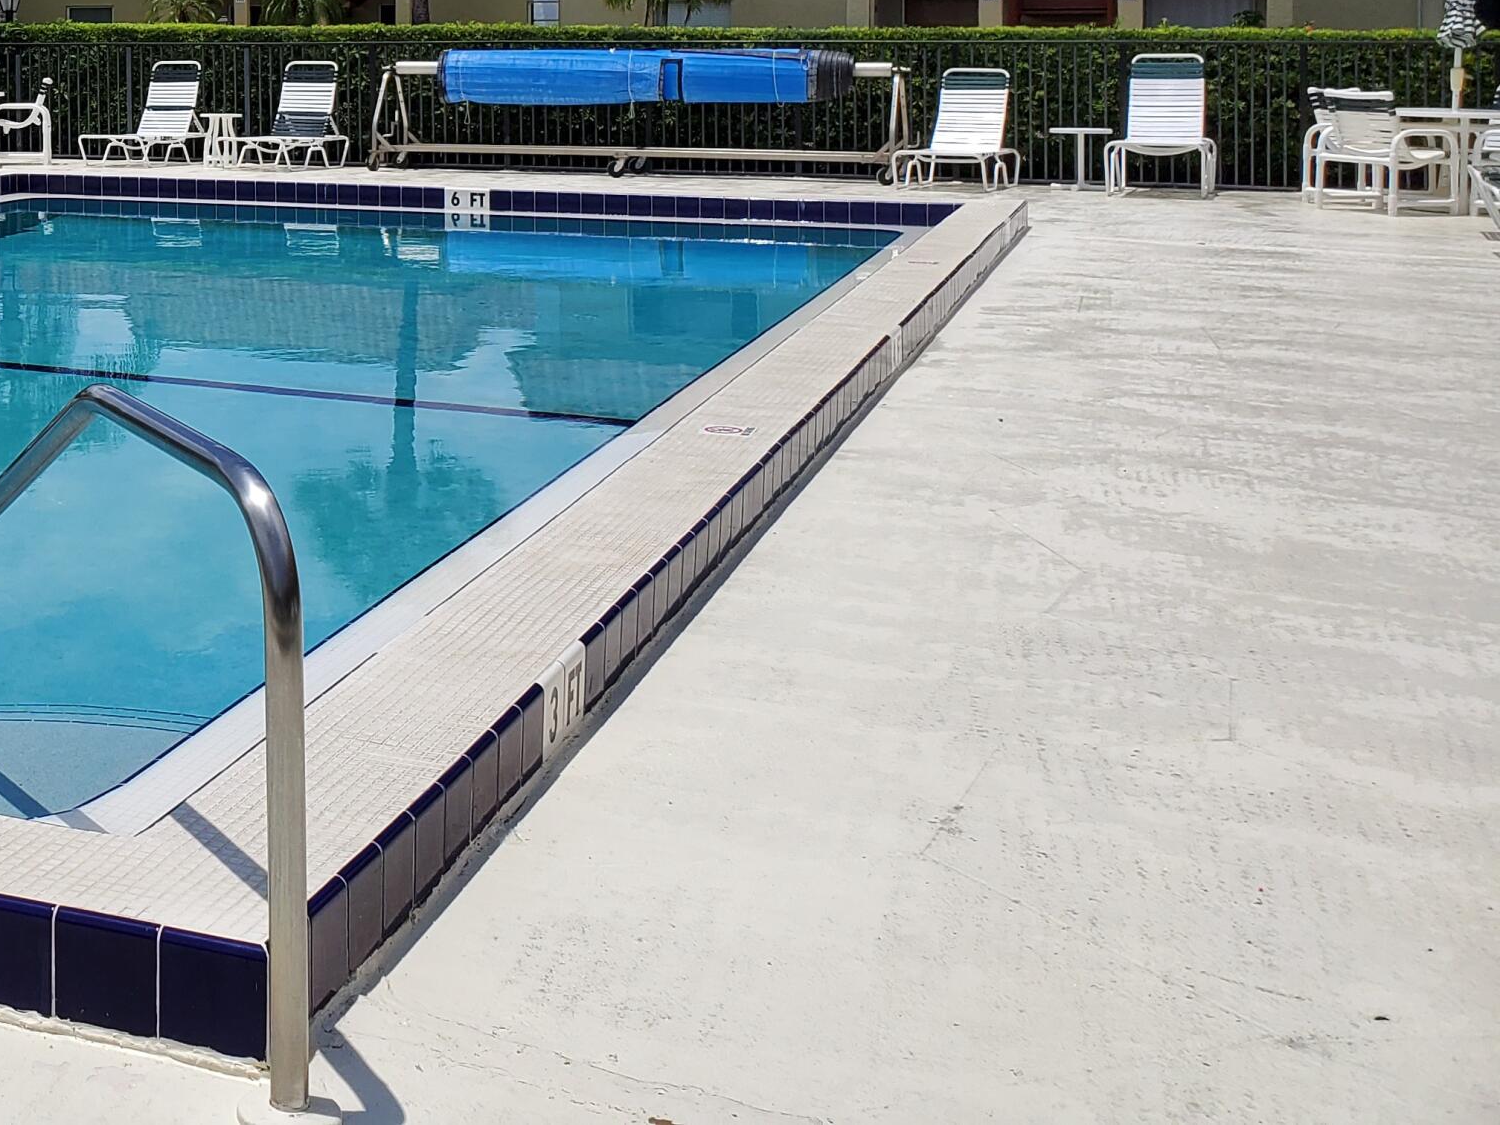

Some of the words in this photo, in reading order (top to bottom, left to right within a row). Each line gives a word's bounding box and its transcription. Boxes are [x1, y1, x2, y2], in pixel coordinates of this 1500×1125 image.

[451, 191, 460, 207] 6
[470, 192, 486, 207] FT
[549, 686, 559, 744] 3
[566, 660, 583, 727] FT
